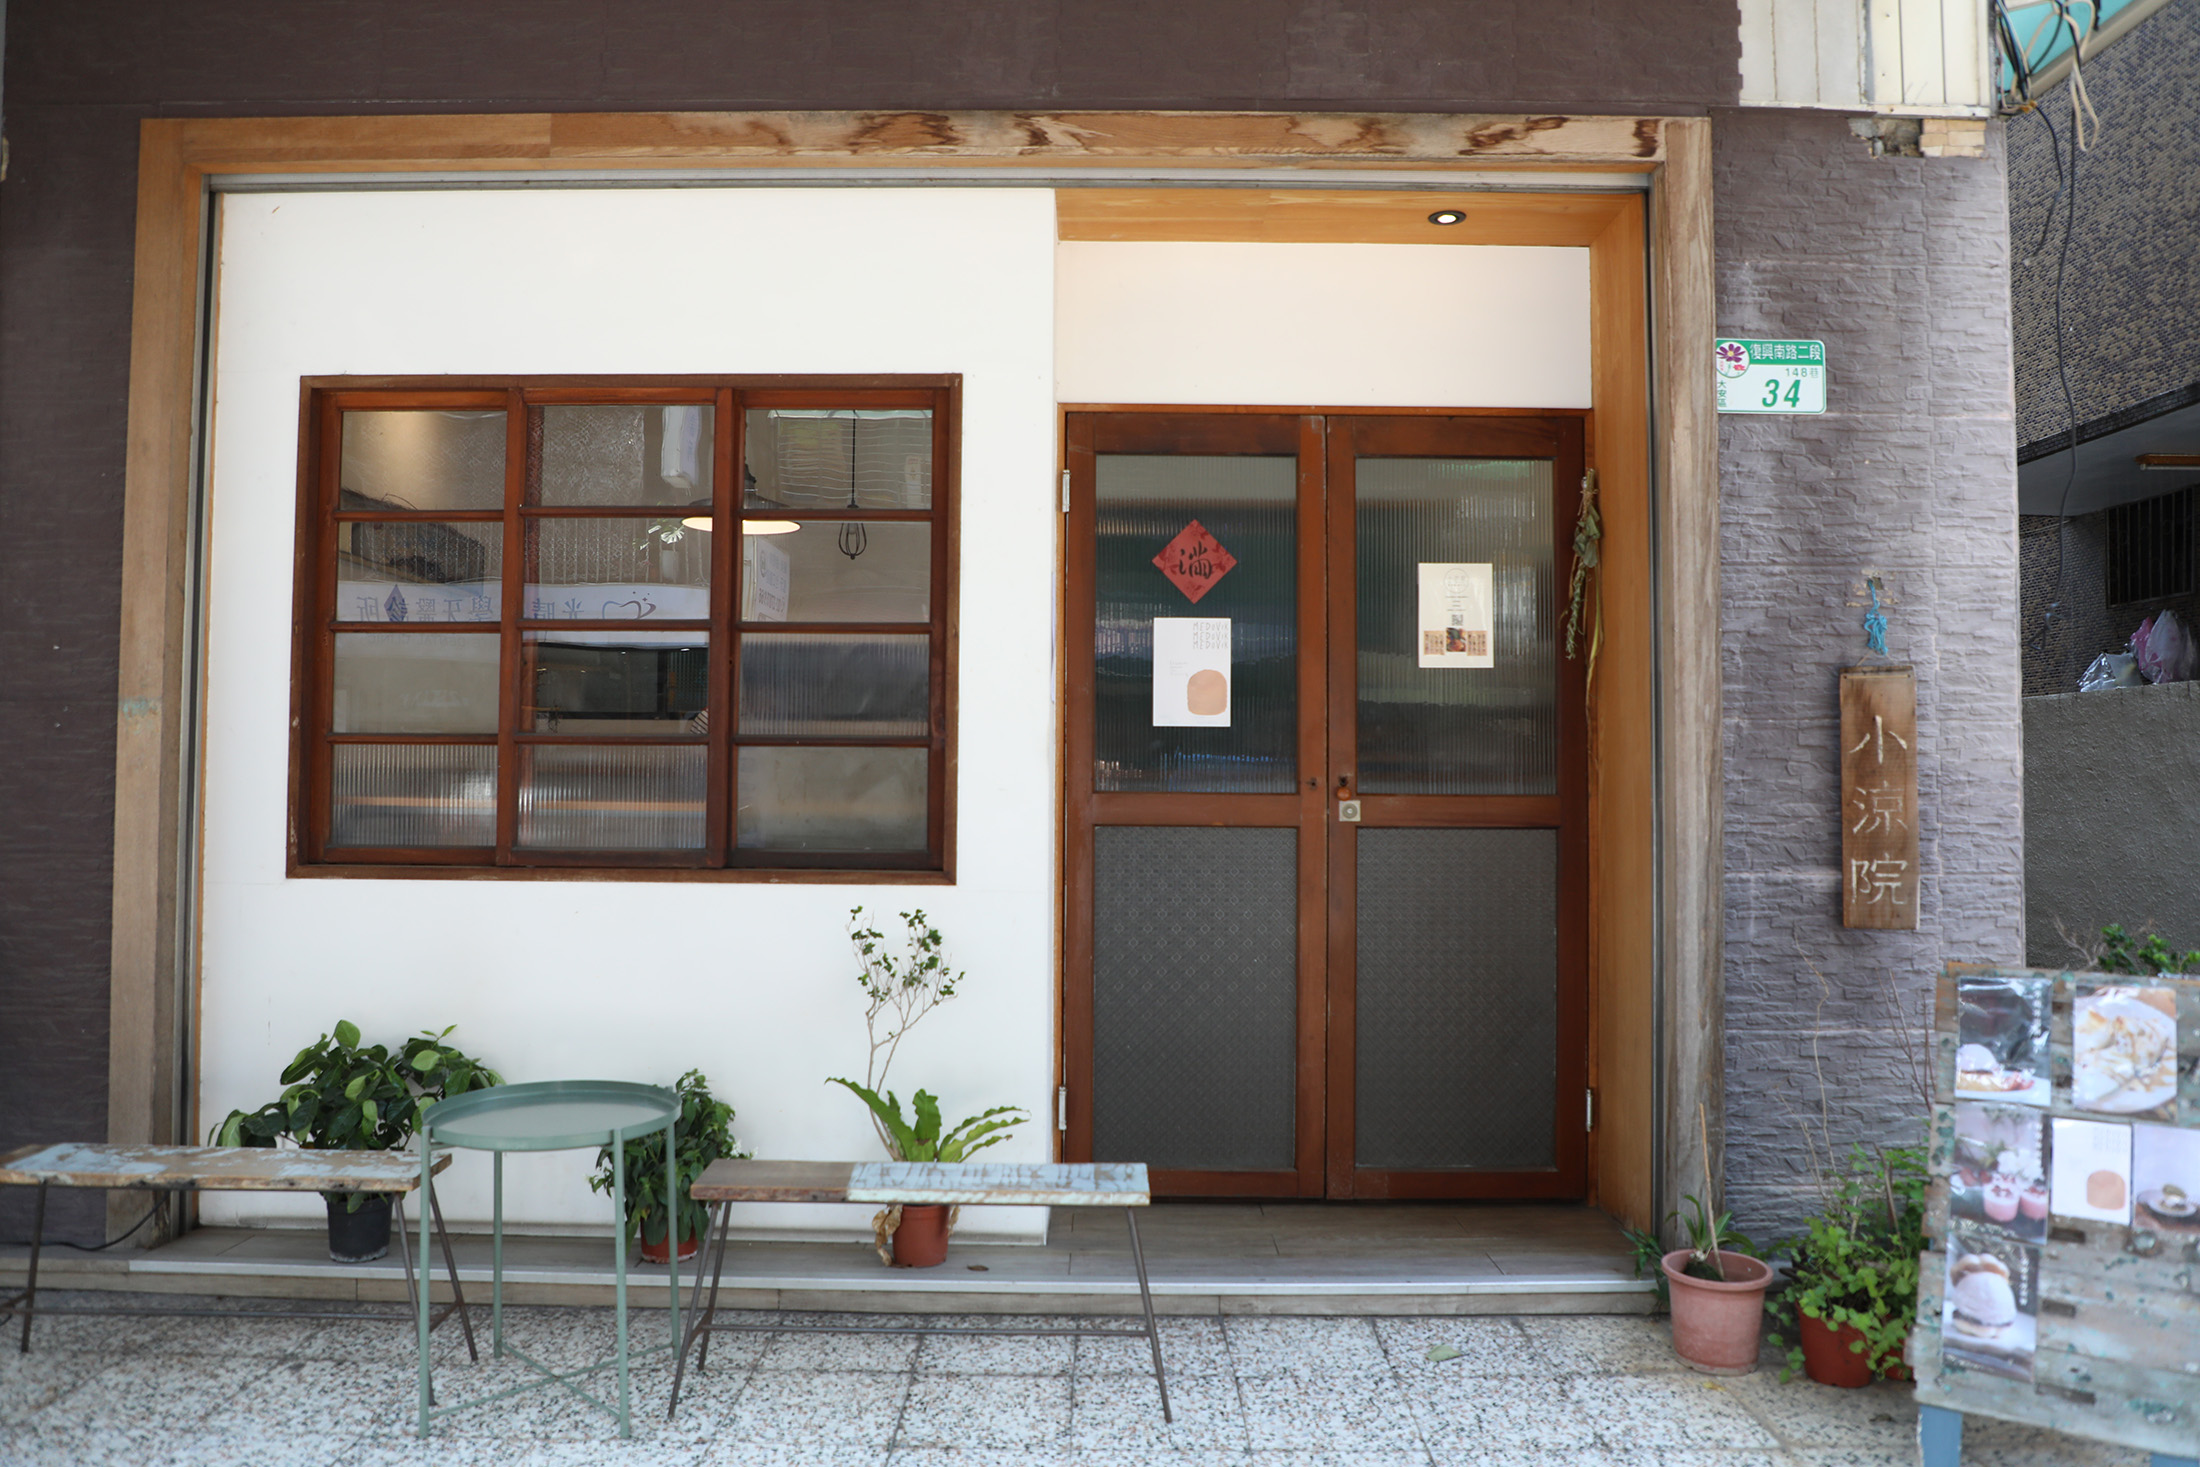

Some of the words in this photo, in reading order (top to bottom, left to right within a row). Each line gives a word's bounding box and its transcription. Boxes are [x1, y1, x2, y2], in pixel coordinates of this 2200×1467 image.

[1749, 343, 1822, 360] 復興南路二段
[1762, 379, 1801, 408] 34
[1850, 715, 1909, 905] 小涼院
